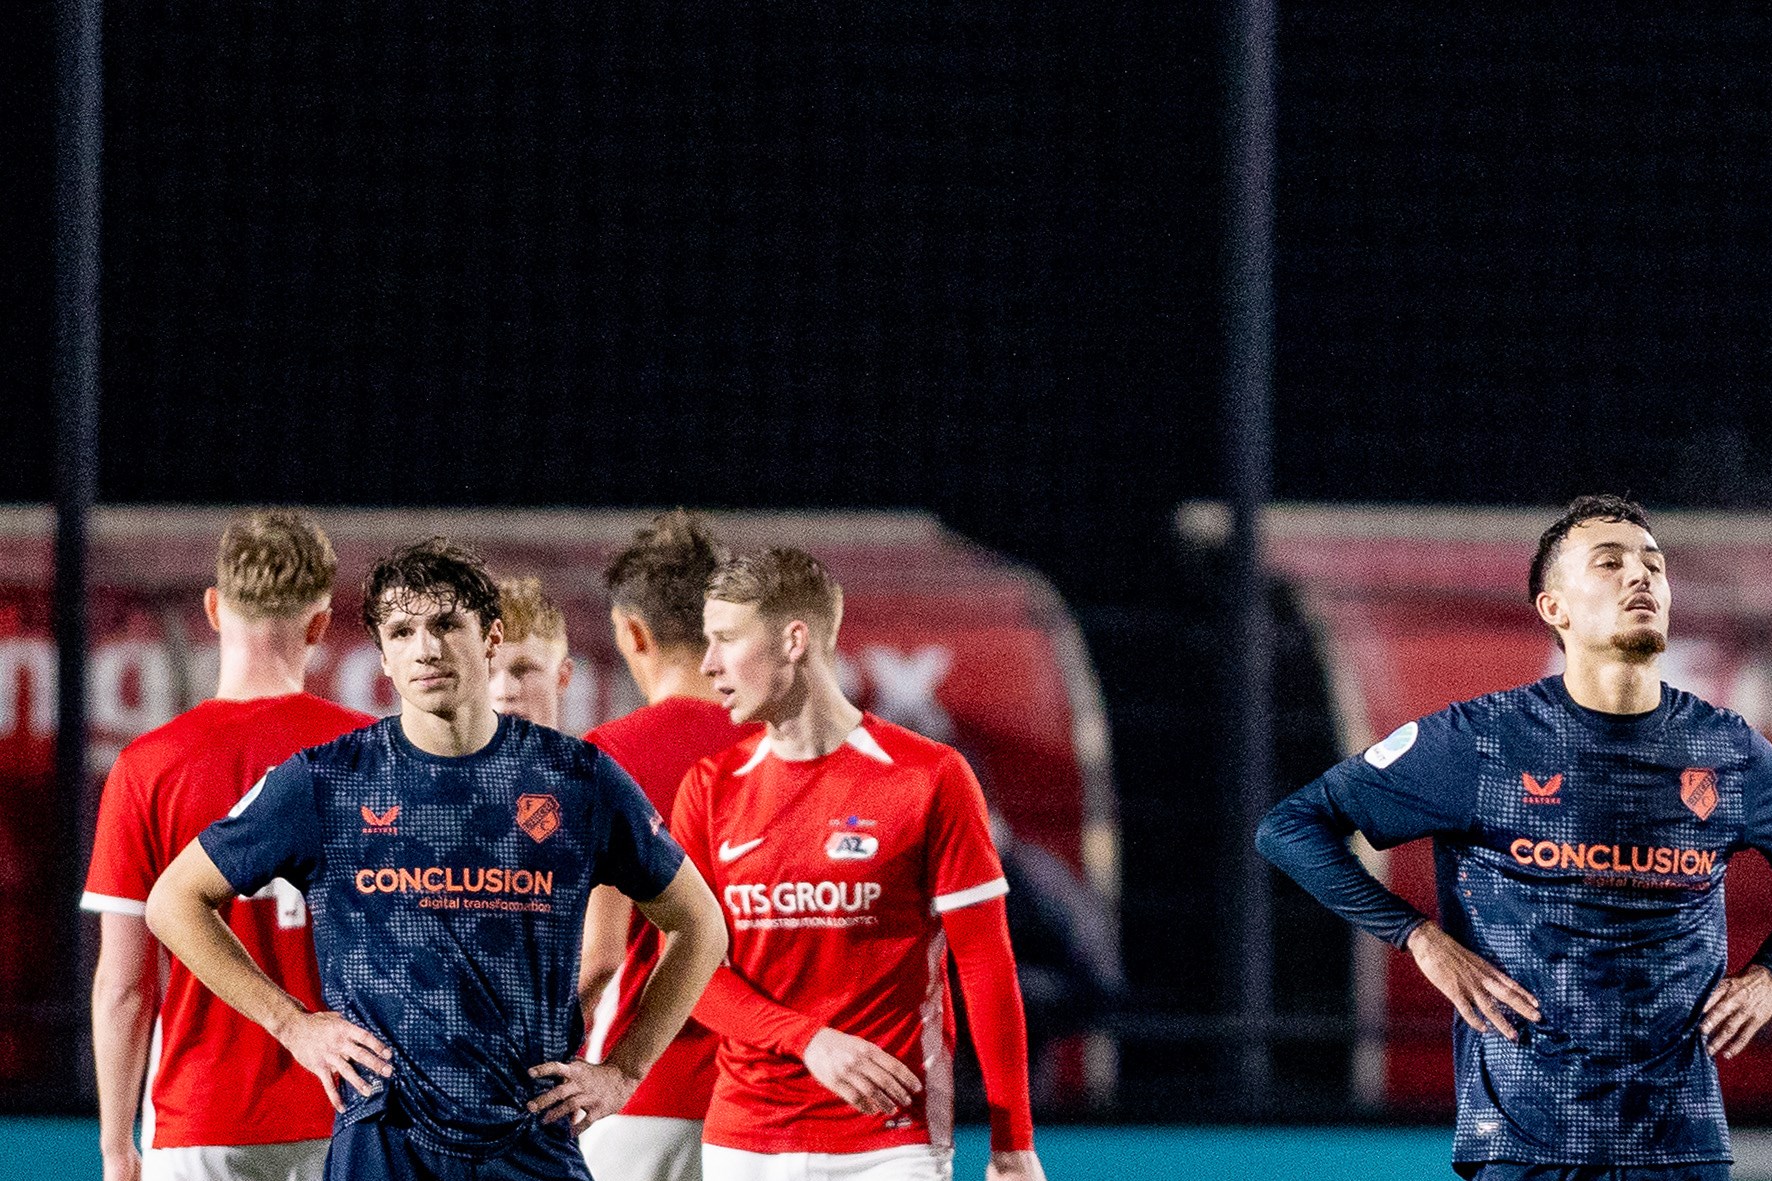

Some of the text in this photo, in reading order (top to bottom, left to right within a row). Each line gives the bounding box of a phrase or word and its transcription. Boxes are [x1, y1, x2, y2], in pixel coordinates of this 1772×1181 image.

[1510, 838, 1717, 875] CONCLUSION
[355, 867, 553, 895] CONCLUSION
[419, 896, 460, 909] digital
[772, 881, 881, 914] GROUP
